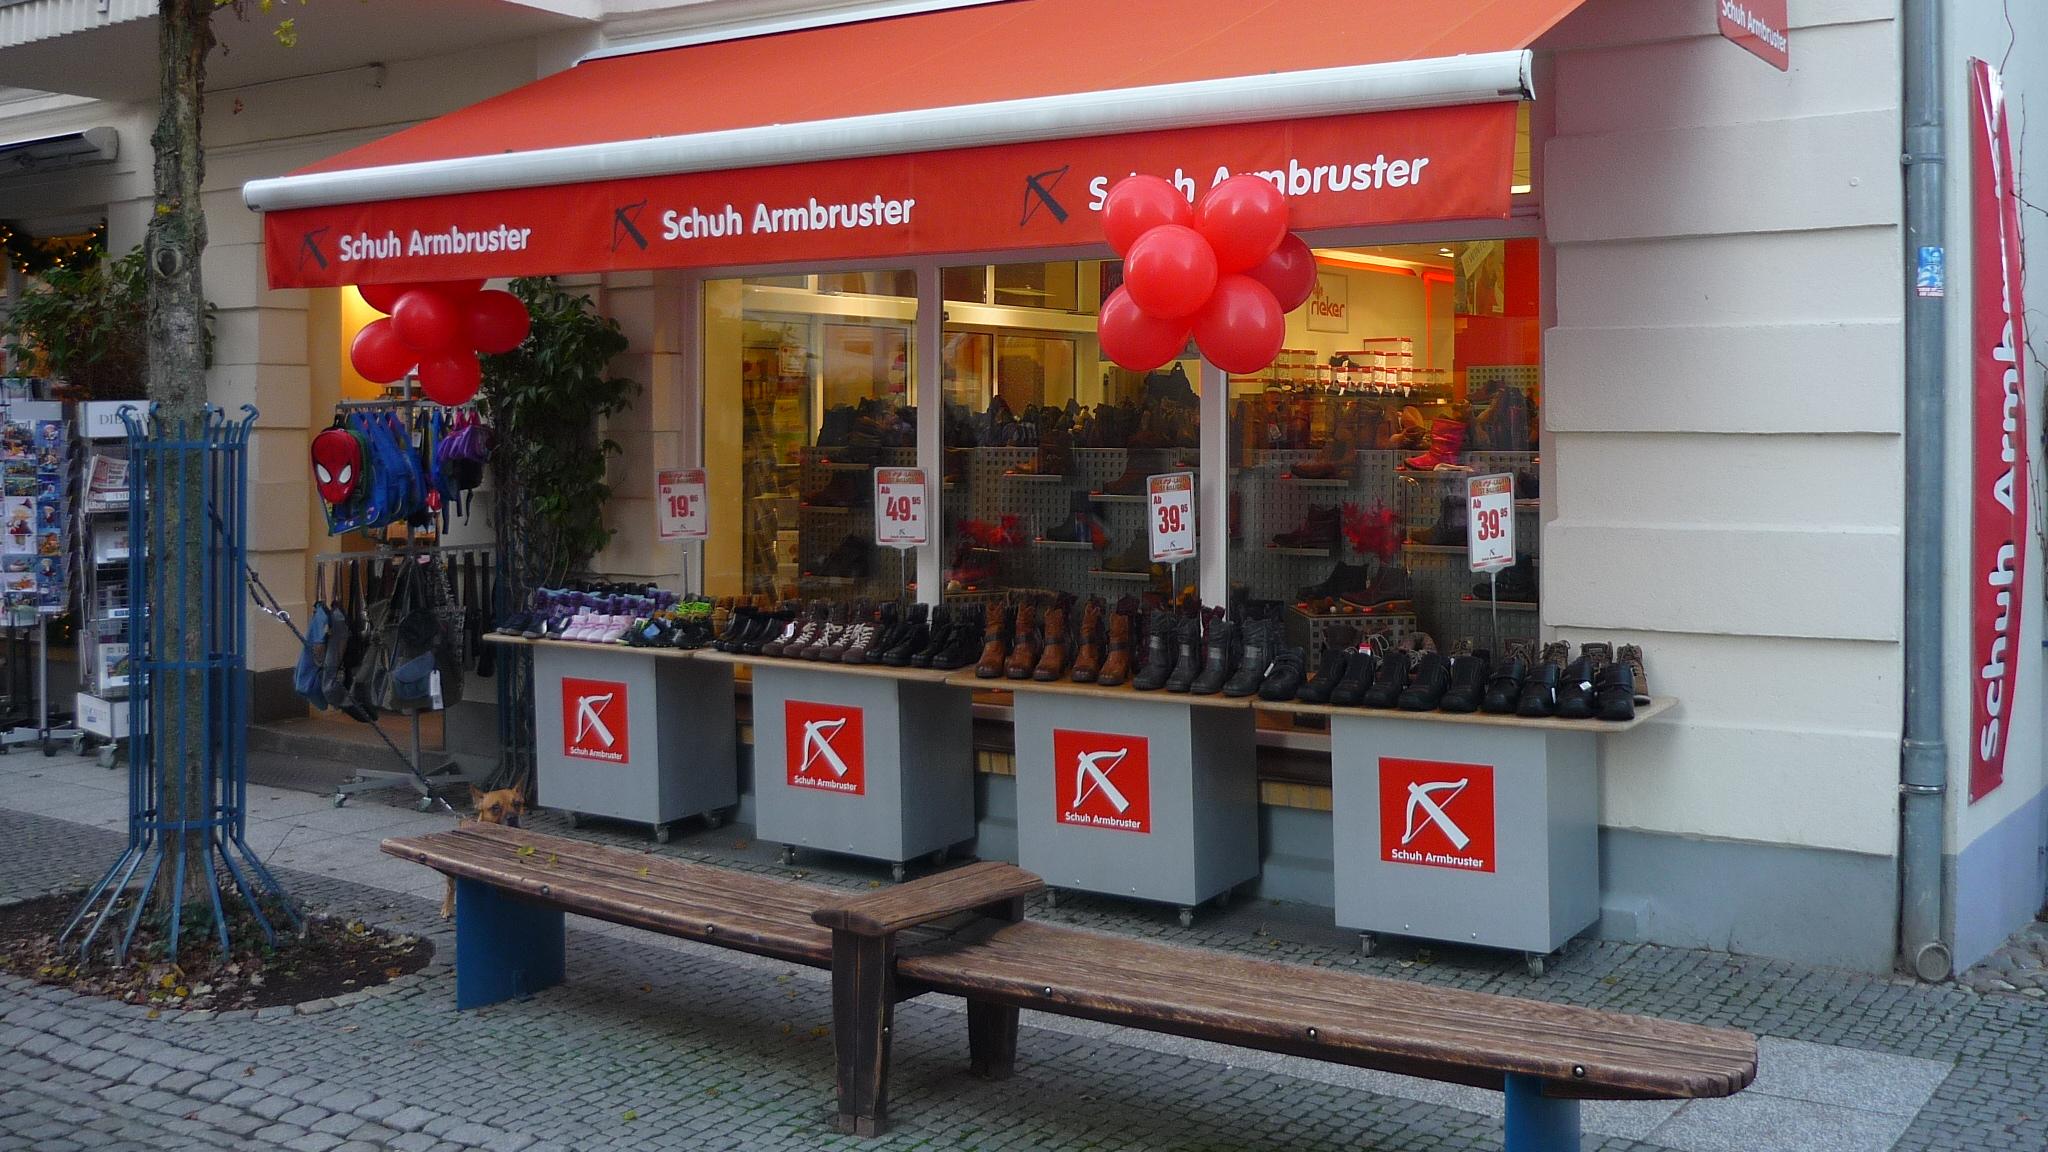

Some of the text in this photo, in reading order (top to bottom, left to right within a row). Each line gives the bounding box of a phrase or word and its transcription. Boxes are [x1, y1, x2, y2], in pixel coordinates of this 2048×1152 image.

[1747, 10, 1787, 54] Armbruster
[663, 195, 915, 241] Schuh Armbruster
[339, 223, 531, 262] Schuh Armbruster
[1311, 296, 1345, 318] rieker
[1980, 544, 2015, 762] Schuh
[794, 775, 857, 791] Schuh Armbruster
[1065, 811, 1141, 828] Schuh Armbruster
[1391, 848, 1484, 868] Schuh Armbruster
